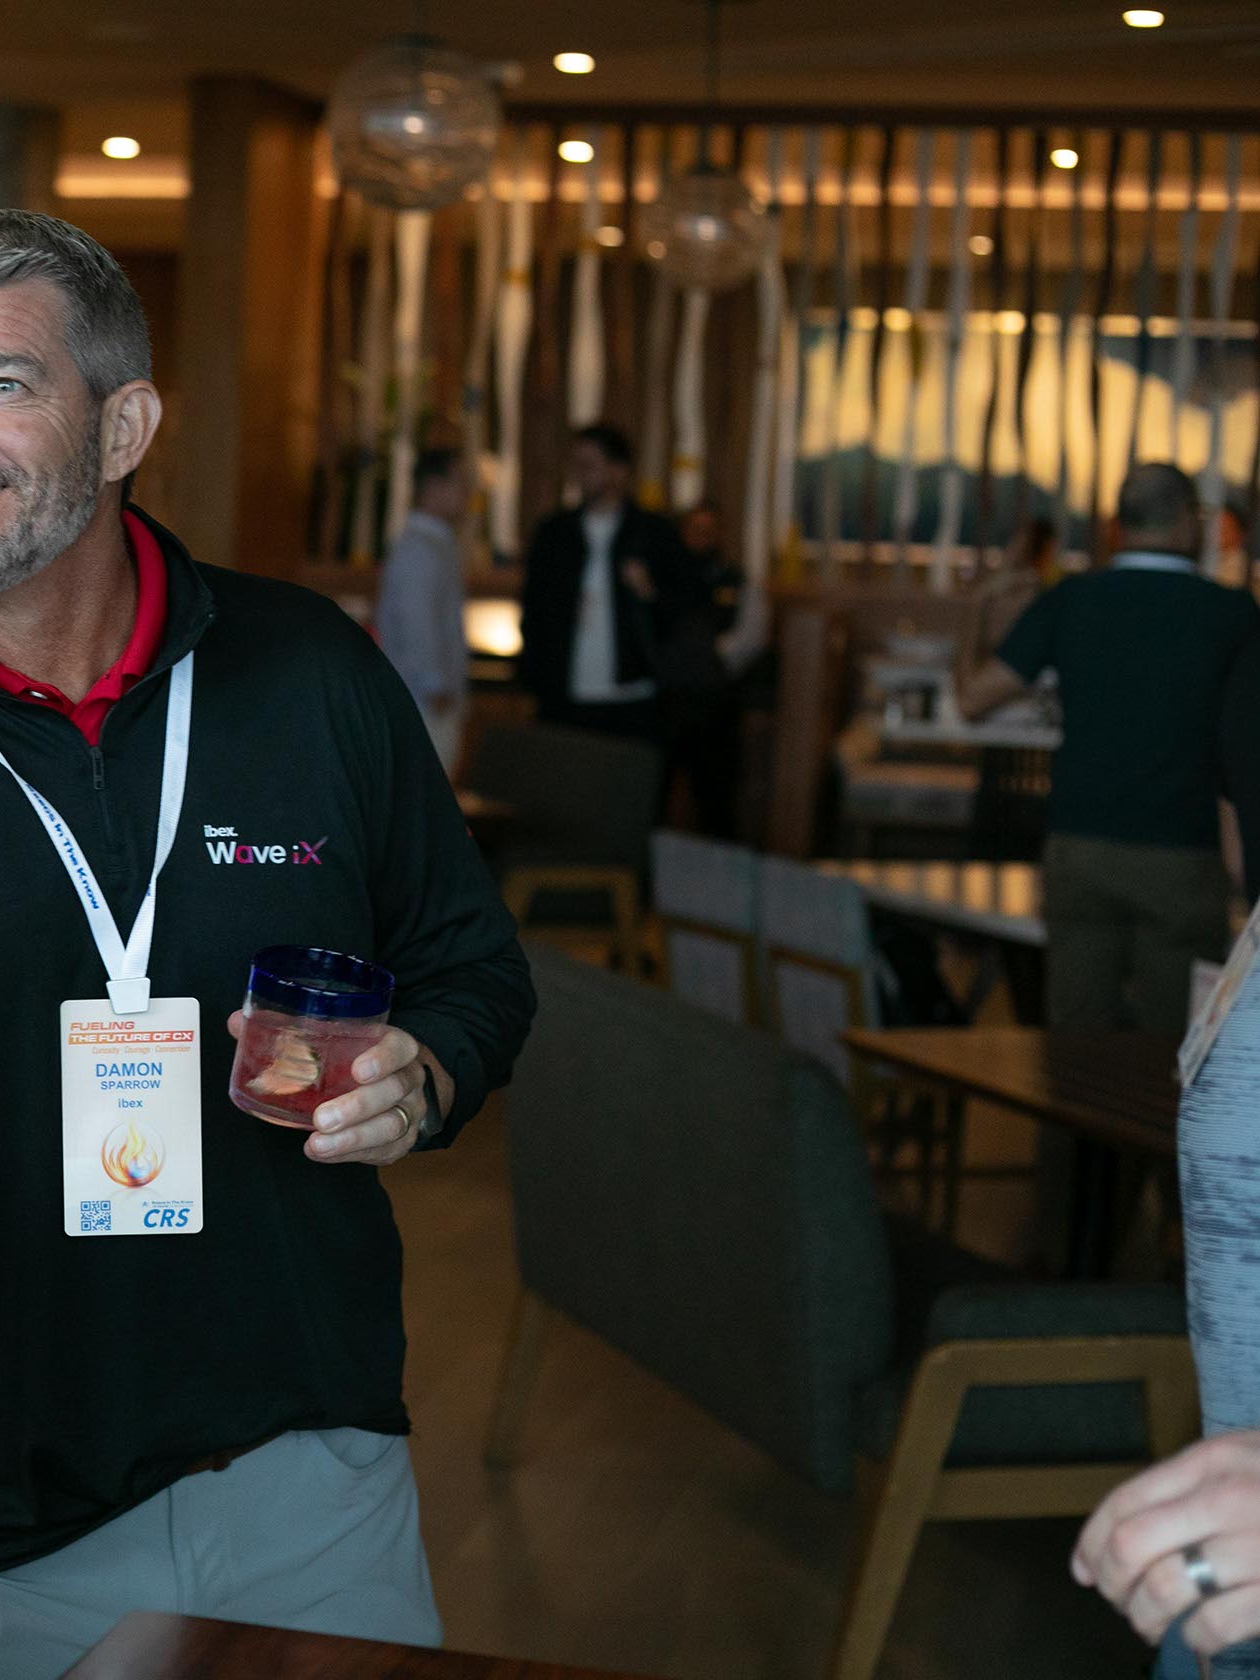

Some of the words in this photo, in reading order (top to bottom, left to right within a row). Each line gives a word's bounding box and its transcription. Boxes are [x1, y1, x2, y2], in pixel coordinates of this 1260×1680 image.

[205, 841, 287, 865] Wave
[292, 836, 329, 865] iX
[54, 823, 64, 837] In
[63, 838, 79, 866] The
[76, 867, 99, 909] Know
[70, 1021, 135, 1031] FUELING
[71, 1034, 97, 1043] THE
[98, 1033, 151, 1042] FUTURE
[152, 1032, 171, 1041] OF
[172, 1031, 192, 1041] CX
[96, 1062, 163, 1077] DAMON
[100, 1079, 161, 1090] SPARROW
[118, 1098, 143, 1108] ibex
[143, 1208, 191, 1228] CRS
